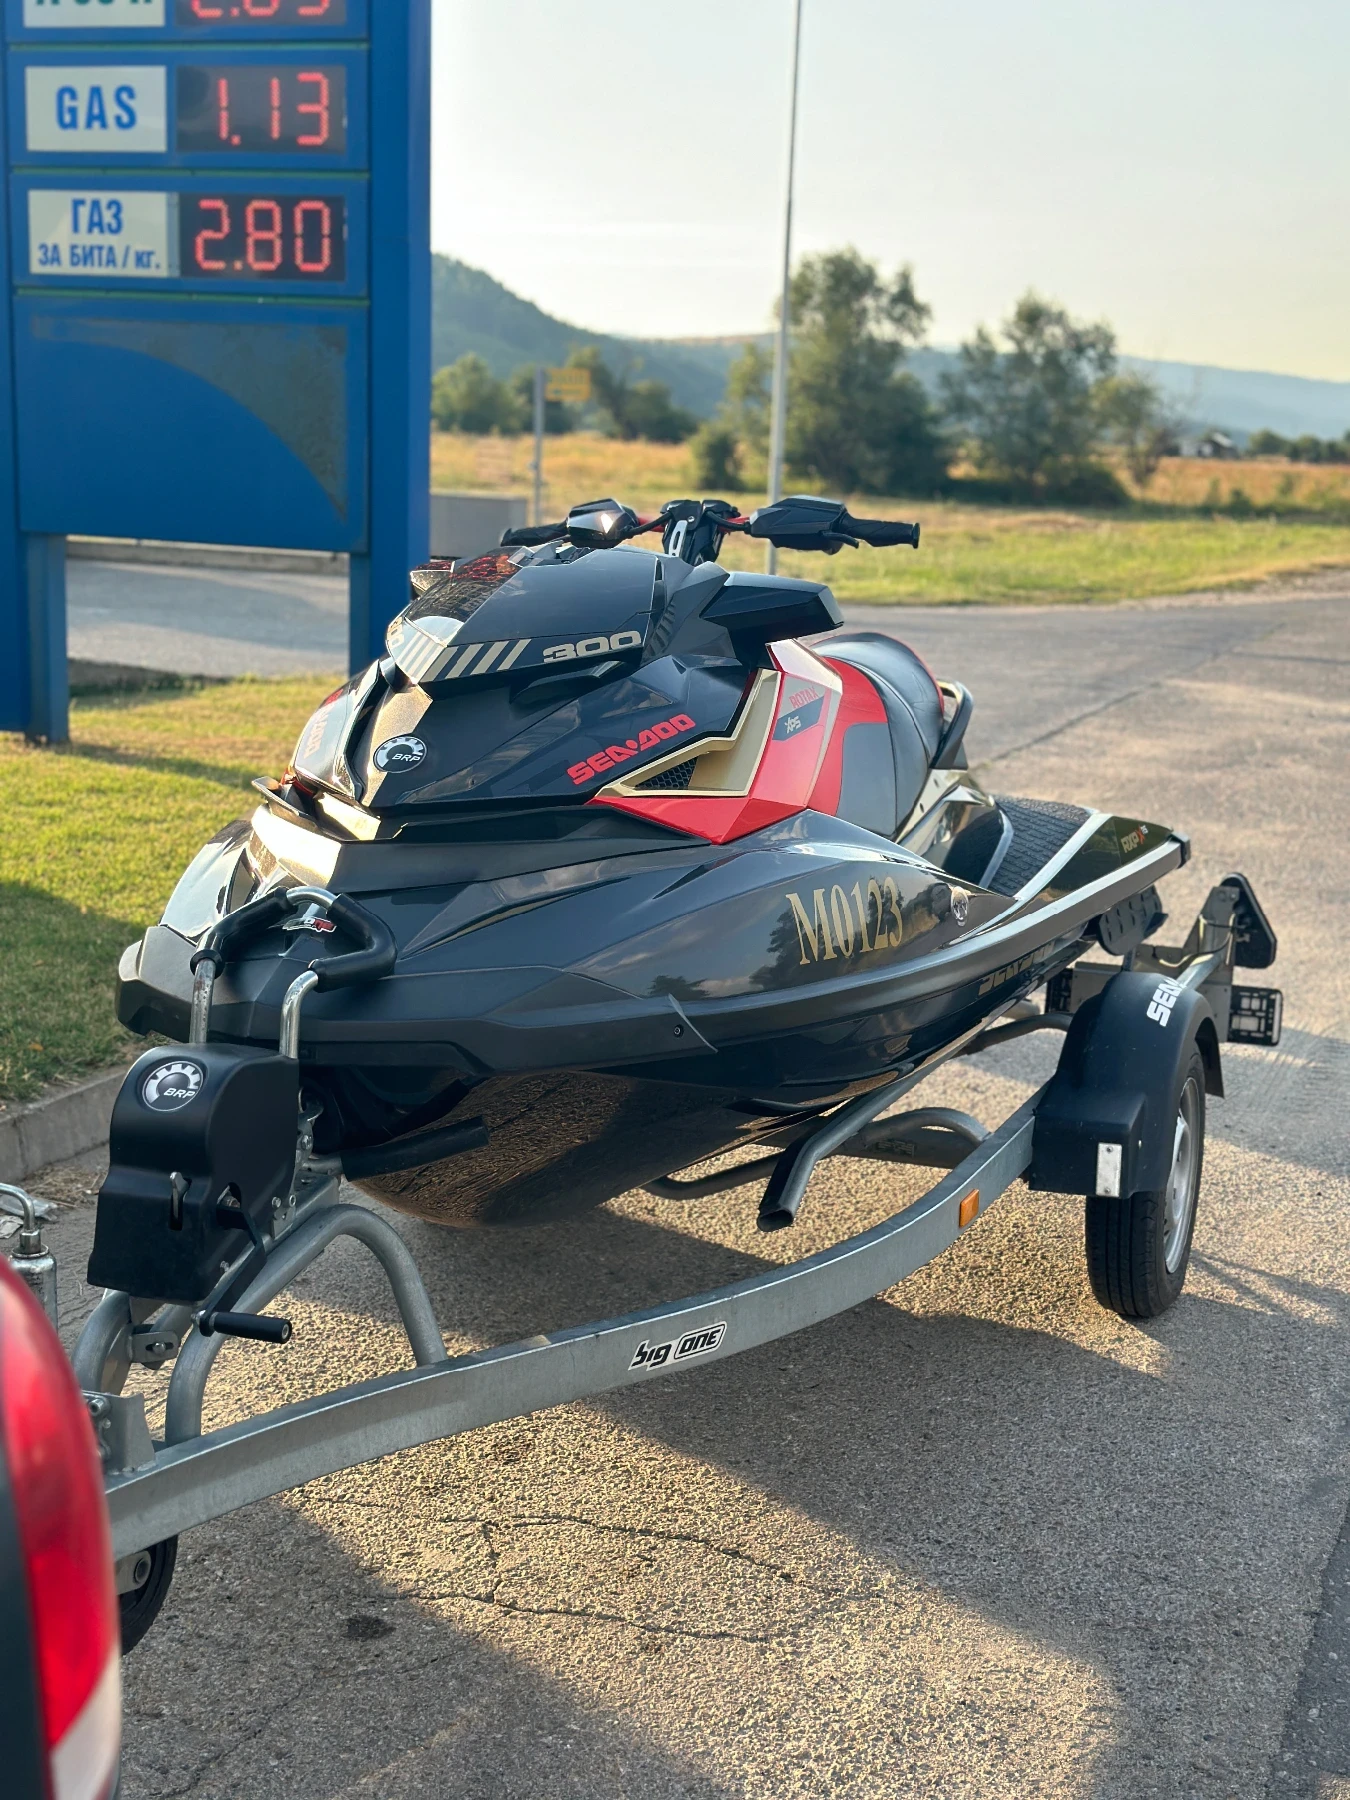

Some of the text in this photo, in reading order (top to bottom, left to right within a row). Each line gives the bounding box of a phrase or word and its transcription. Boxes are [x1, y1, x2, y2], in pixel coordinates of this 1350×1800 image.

[55, 85, 137, 130] GAS
[217, 72, 330, 145] 1.13
[71, 198, 123, 235] ГАЗ
[195, 199, 331, 272] 2.80
[38, 243, 61, 267] ЗА
[69, 244, 117, 269] БИТА
[542, 630, 642, 664] 300
[788, 686, 820, 709] ROTAX
[391, 753, 421, 762] BRP
[163, 1087, 196, 1099] BRP
